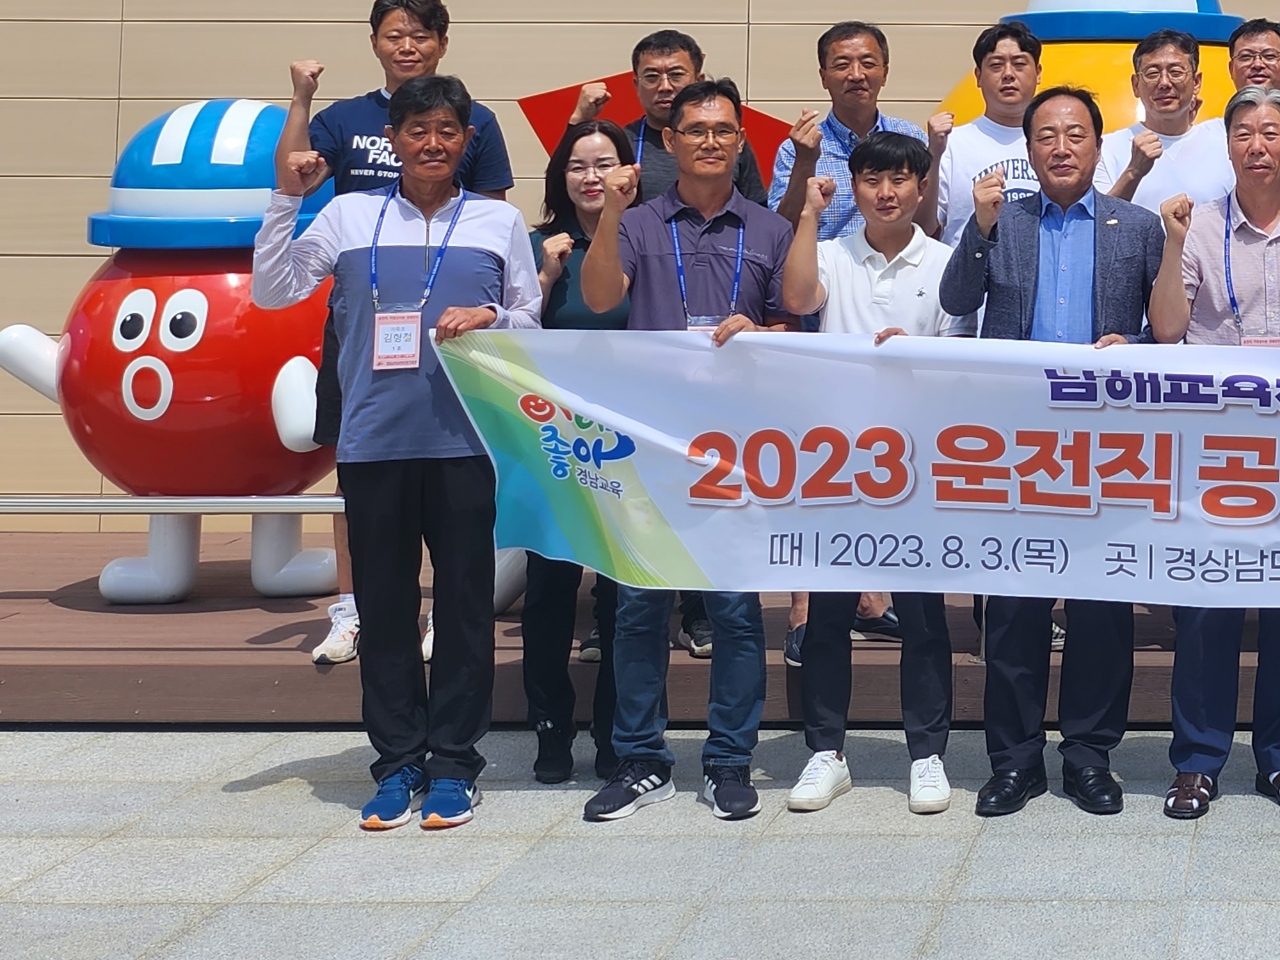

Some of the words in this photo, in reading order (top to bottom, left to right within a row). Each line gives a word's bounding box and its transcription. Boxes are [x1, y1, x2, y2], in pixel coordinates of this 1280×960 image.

[352, 135, 393, 152] NOR
[367, 150, 403, 167] FAC
[377, 170, 400, 178] STOP
[688, 427, 908, 501] 2023
[931, 425, 1173, 514] 운전직
[576, 467, 623, 499] 경남교육
[769, 531, 803, 568] 때
[829, 533, 932, 568] 2023.
[1103, 542, 1138, 578] 곳
